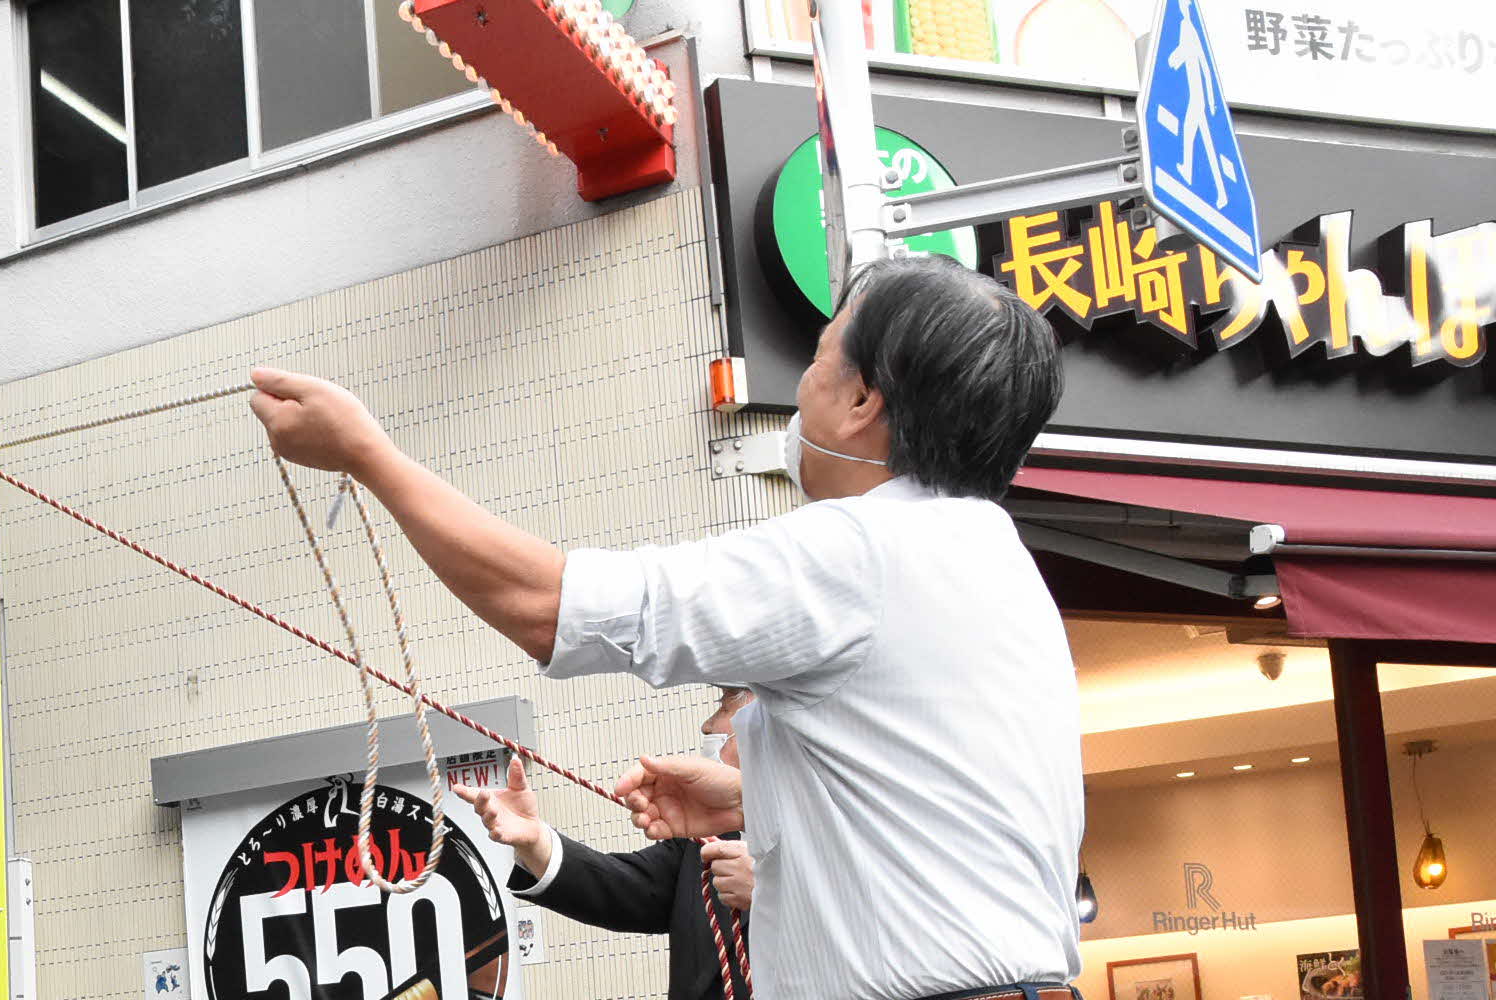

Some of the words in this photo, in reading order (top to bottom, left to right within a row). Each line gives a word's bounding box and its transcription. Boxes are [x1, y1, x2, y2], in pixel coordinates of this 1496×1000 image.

[1245, 8, 1496, 74] 野菜たっぷり
[447, 764, 498, 791] NEW!
[360, 791, 453, 837] 白湯スープ
[263, 828, 427, 899] つけめん
[1152, 911, 1219, 936] Ringer
[1222, 910, 1257, 931] Hut
